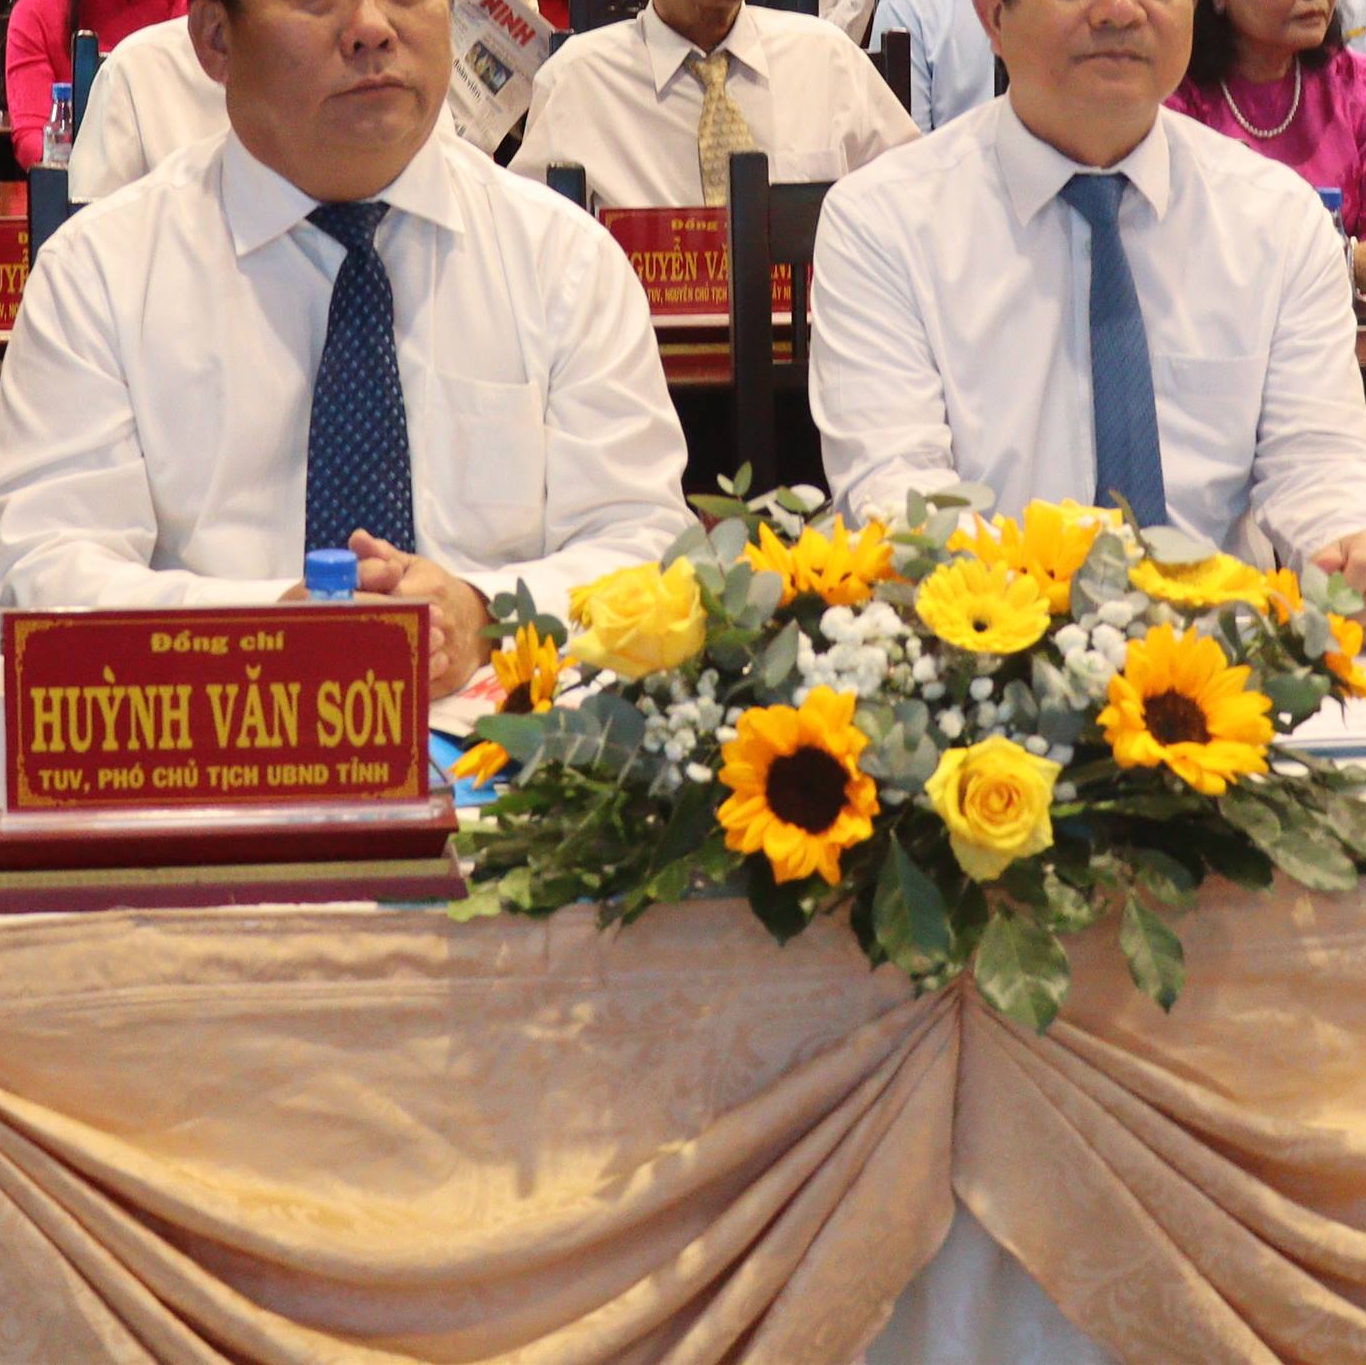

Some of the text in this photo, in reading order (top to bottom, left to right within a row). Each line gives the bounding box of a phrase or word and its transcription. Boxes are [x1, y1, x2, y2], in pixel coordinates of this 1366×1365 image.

[671, 218, 718, 232] Đồng
[630, 237, 698, 283] GUYỄN
[151, 631, 284, 655] Đồng chí
[30, 663, 405, 754] HUỲNH VĂN SƠN
[39, 757, 389, 793] TUV, PHÓ CHỦ TỊCH UBND TỈNH
